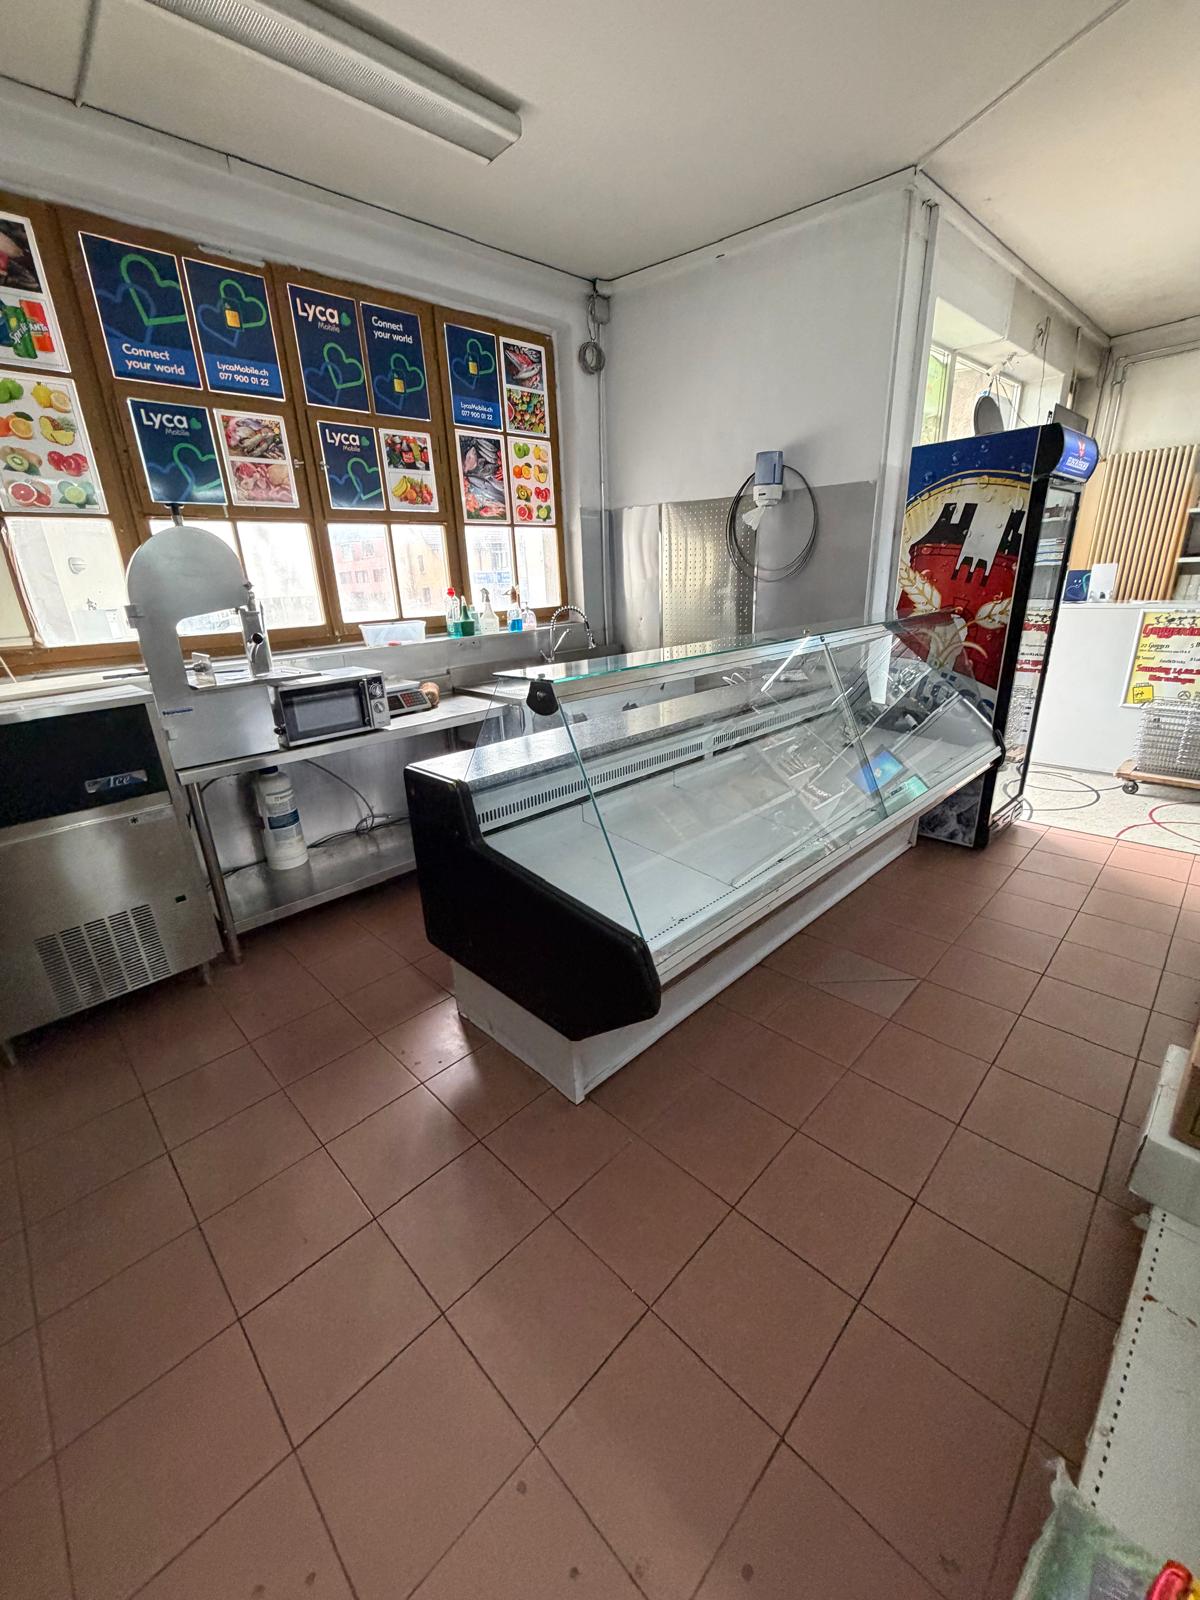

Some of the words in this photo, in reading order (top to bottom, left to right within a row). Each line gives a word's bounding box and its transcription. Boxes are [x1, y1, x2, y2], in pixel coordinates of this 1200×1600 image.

[296, 297, 340, 325] Lyca
[318, 321, 340, 334] Mobile
[371, 315, 404, 332] Connect
[373, 330, 391, 340] your
[391, 333, 414, 345] world
[121, 343, 170, 361] Connect
[125, 359, 151, 371] your
[153, 363, 186, 376] world
[216, 360, 269, 377] LycaMobile.ch
[219, 371, 233, 381] 077
[233, 374, 250, 384] 900
[250, 376, 259, 385] 01
[260, 378, 270, 387] 22
[460, 401, 494, 413] LycaMobile.ch
[140, 408, 189, 430] Lyca
[165, 427, 190, 437] Mobile
[325, 428, 361, 446] Lyca
[109, 776, 130, 788] Ice
